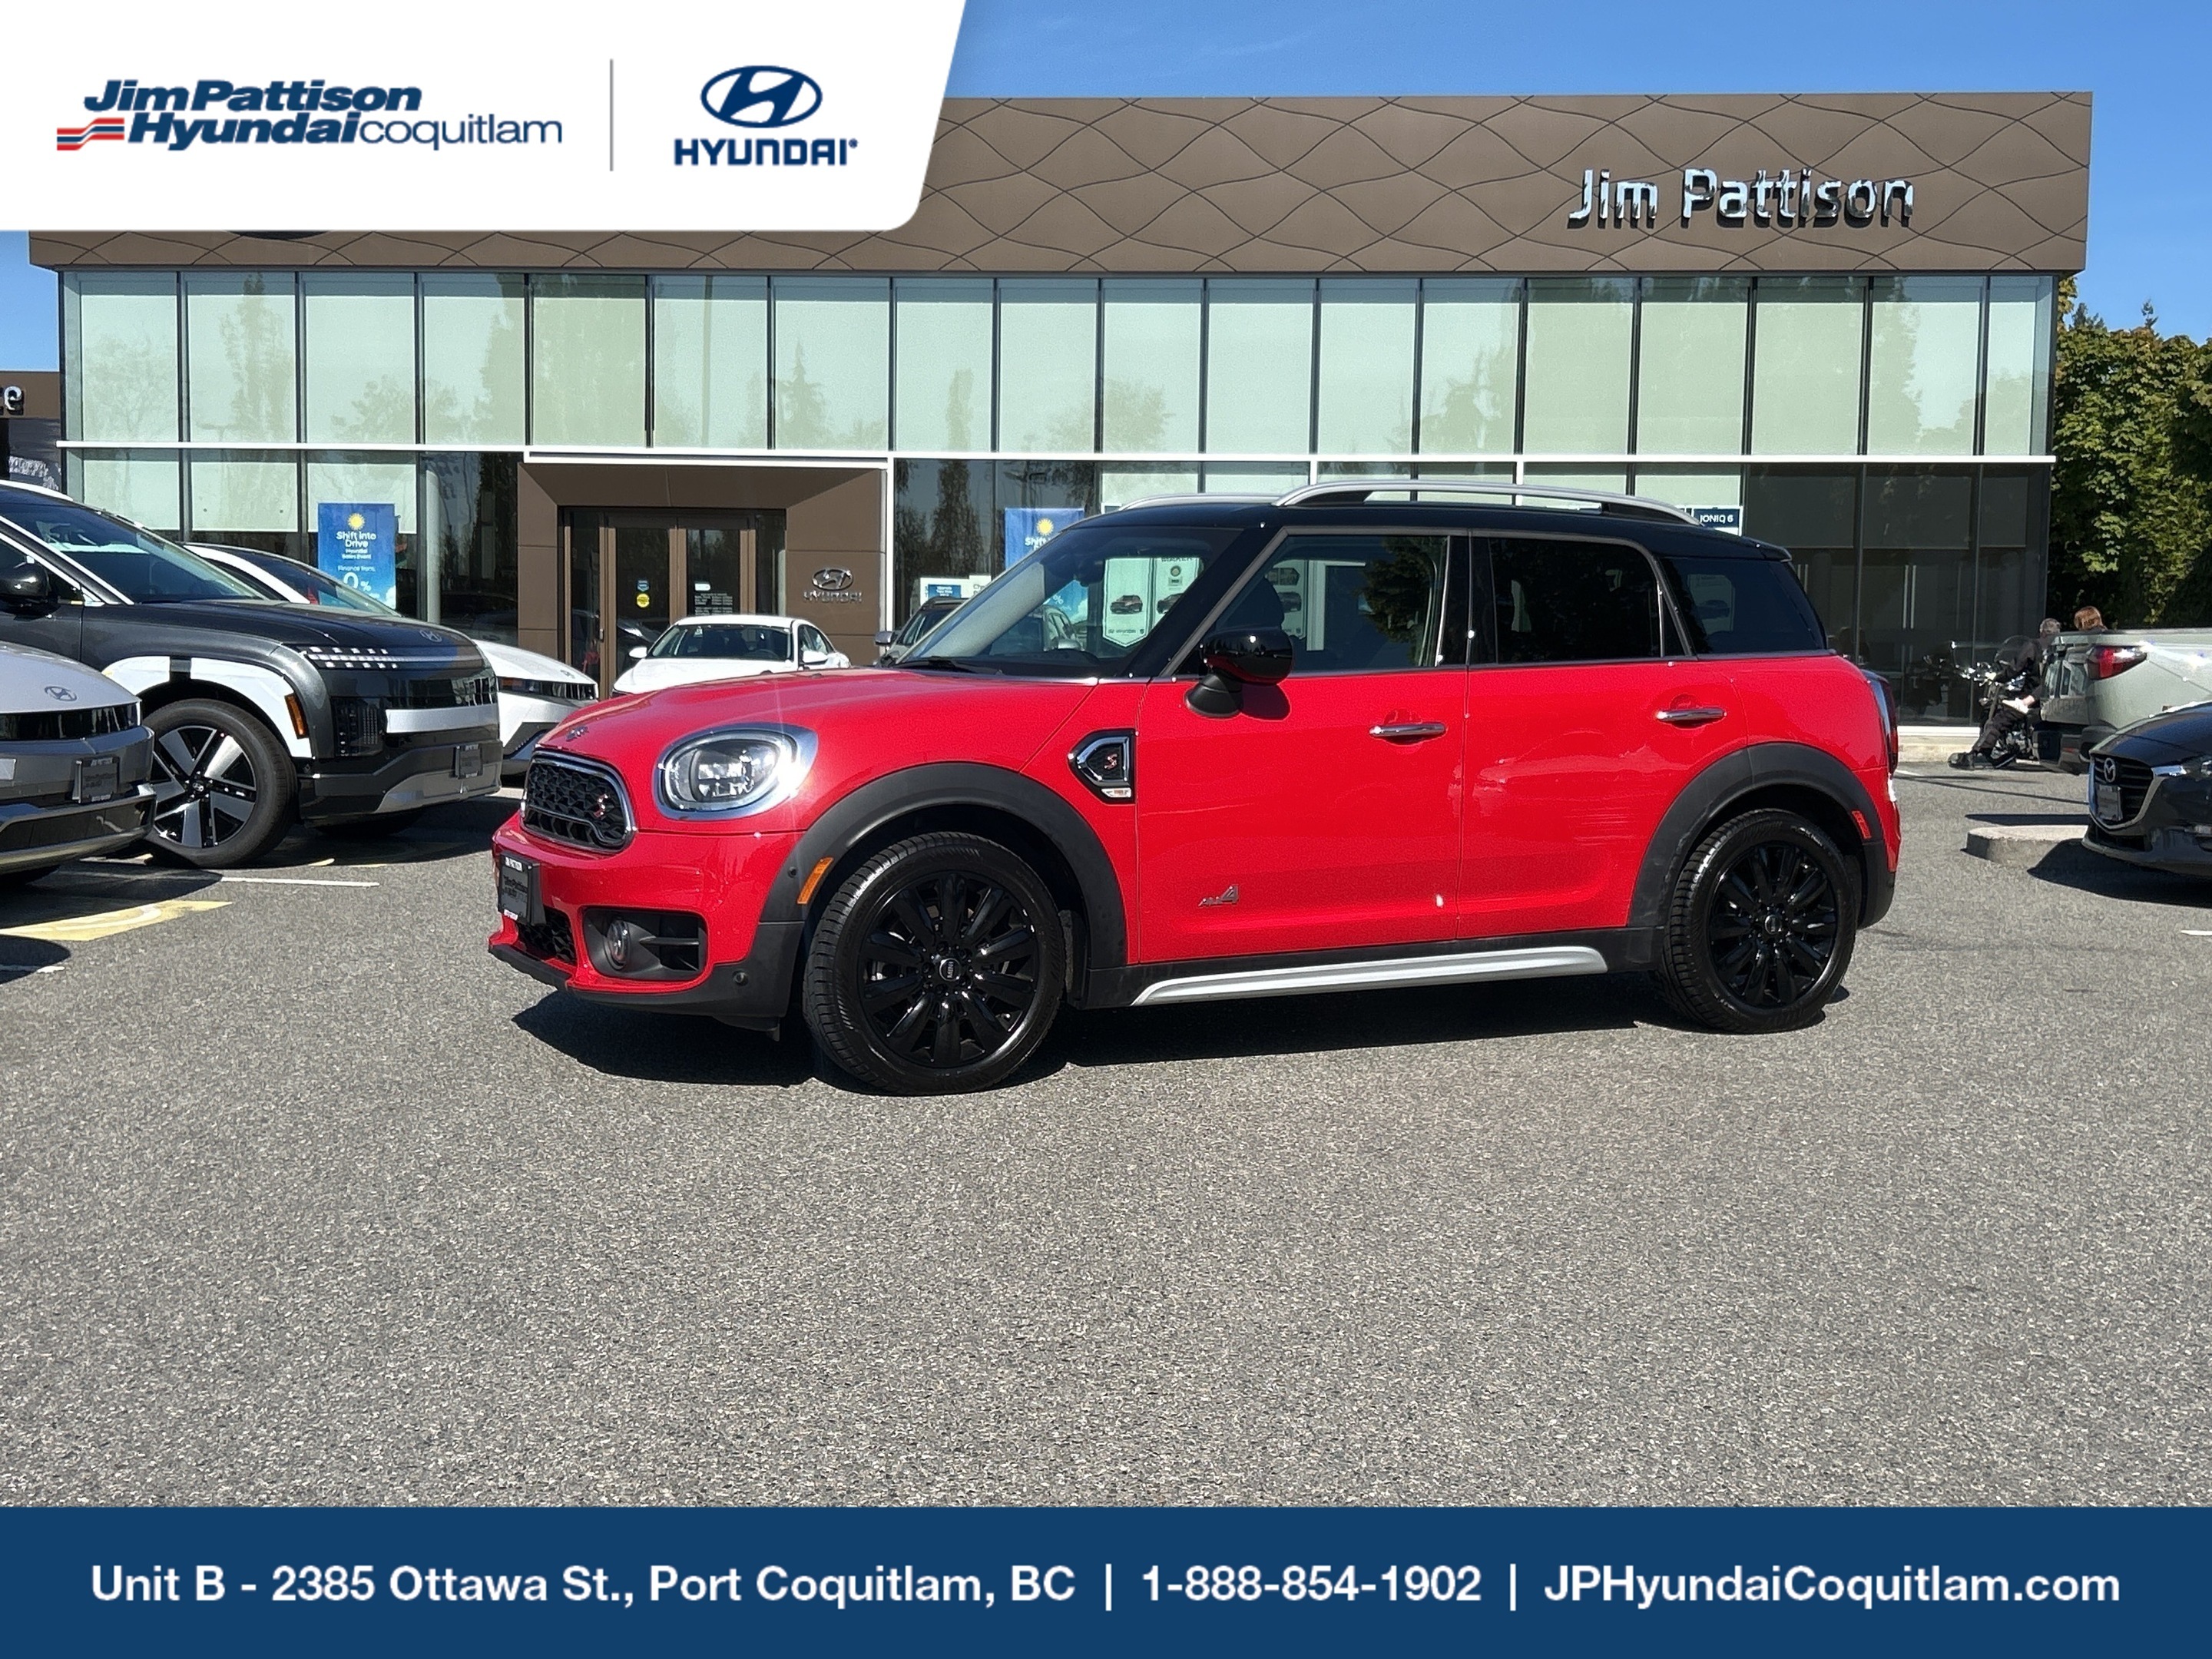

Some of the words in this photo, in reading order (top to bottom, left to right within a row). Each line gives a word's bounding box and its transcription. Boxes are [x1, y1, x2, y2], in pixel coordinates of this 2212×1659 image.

[1568, 169, 1659, 220] Jim
[1682, 166, 1915, 220] Pattison
[1700, 514, 1726, 524] IONIQ
[1727, 515, 1734, 523] 6
[336, 531, 357, 541] Shift
[359, 531, 377, 540] into
[345, 539, 369, 548] Drive
[803, 590, 863, 603] HYUNDAI
